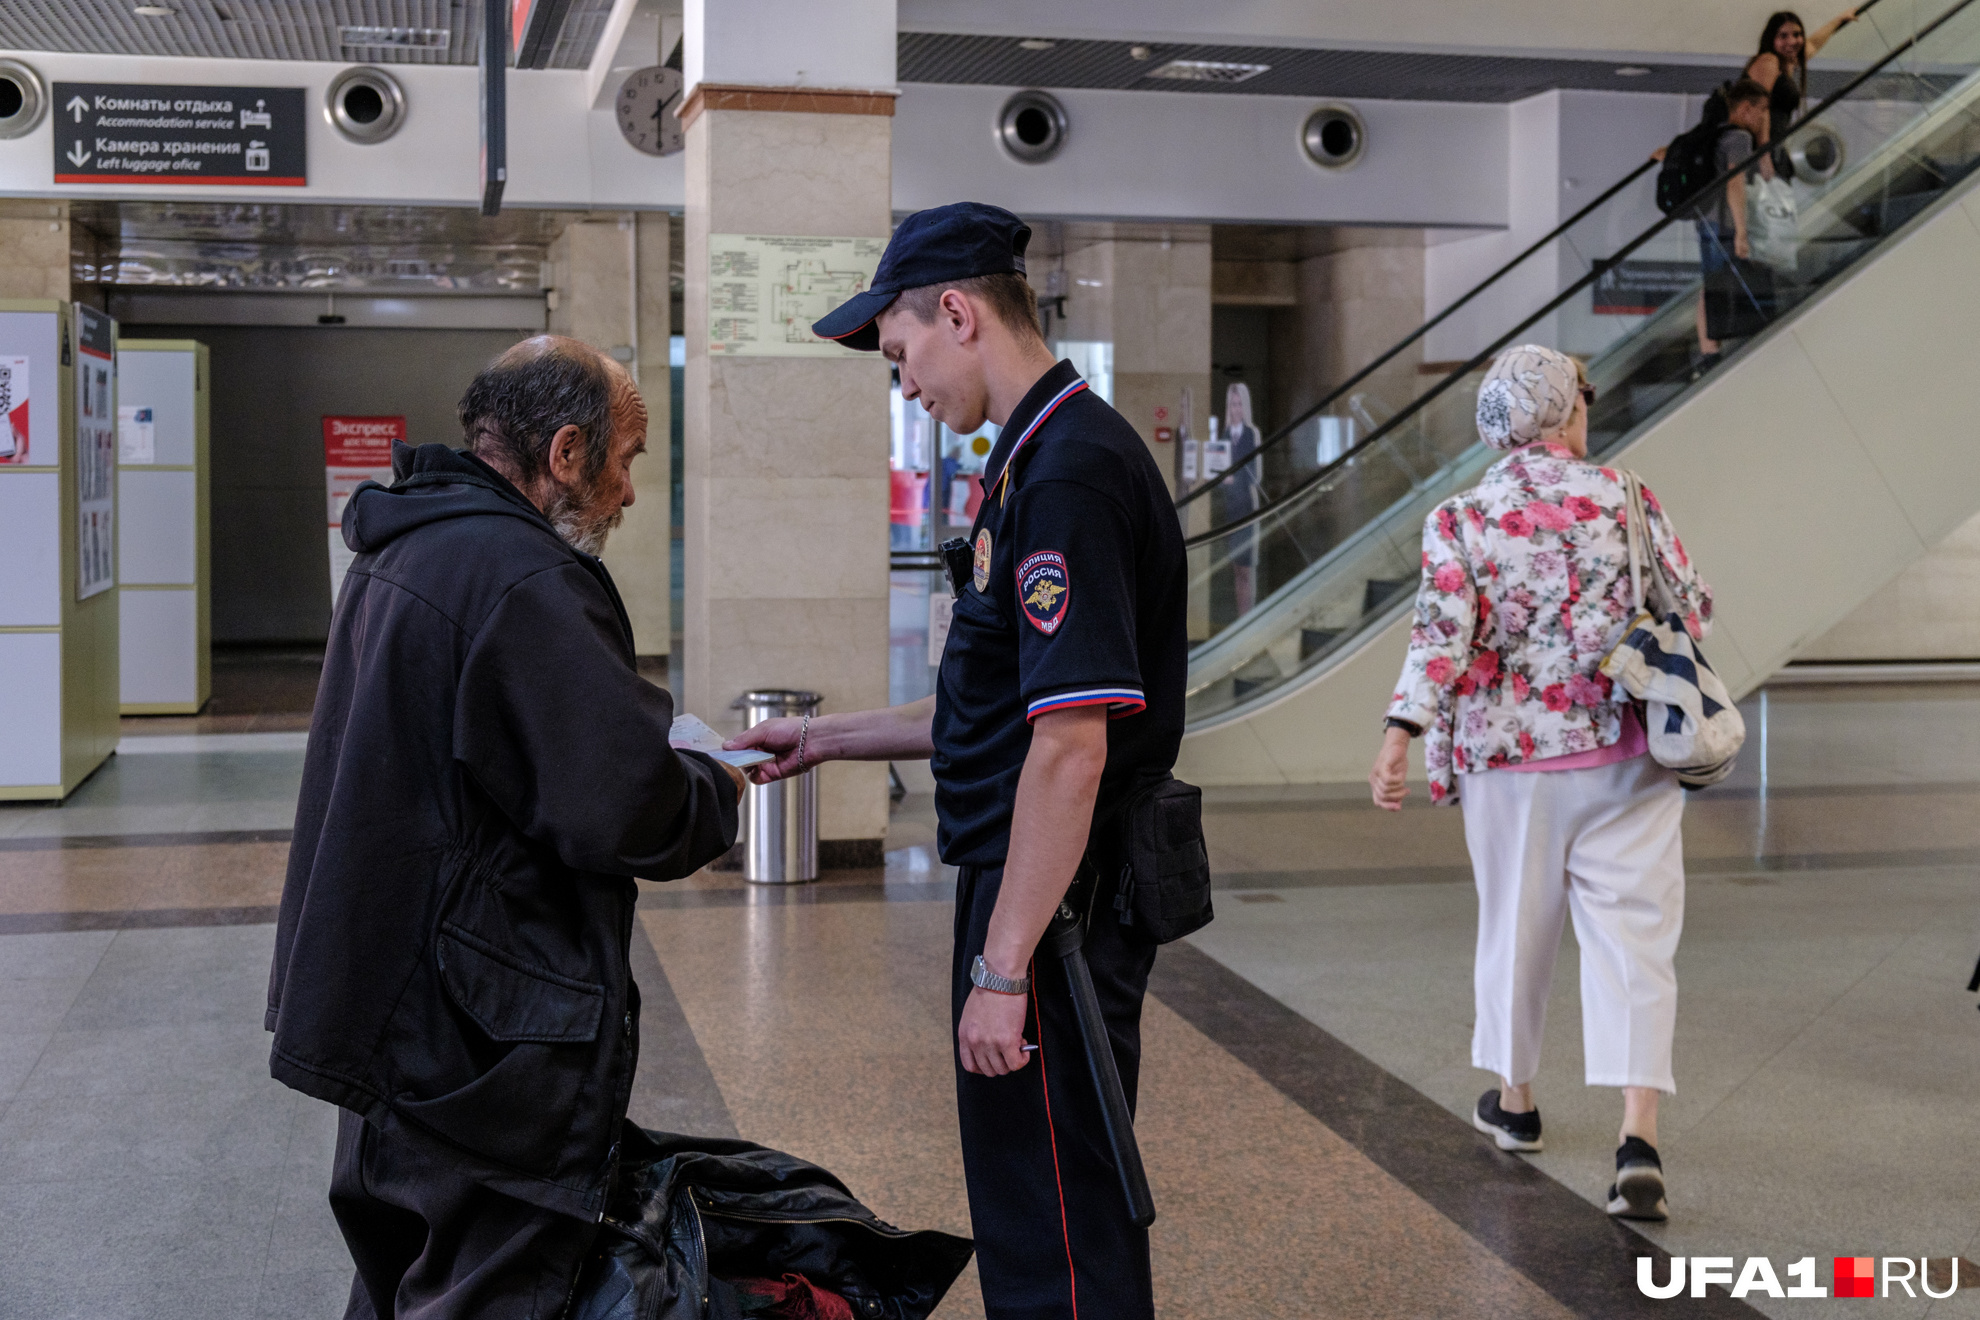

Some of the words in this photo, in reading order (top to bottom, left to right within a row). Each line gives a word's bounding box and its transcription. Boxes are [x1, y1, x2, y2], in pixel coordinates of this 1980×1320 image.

[639, 79, 648, 87] 11
[655, 73, 664, 83] 12
[626, 89, 636, 99] 10
[95, 95, 171, 112] Комнаты
[174, 99, 233, 114] отдыха
[623, 105, 631, 115] 9
[96, 115, 194, 129] Accommodation
[195, 116, 235, 130] service
[673, 134, 680, 144] 5
[95, 138, 160, 157] Камера
[162, 140, 241, 157] хранения
[96, 157, 122, 170] Left
[122, 158, 170, 173] luggage
[332, 420, 397, 437] Экспресс
[1018, 553, 1062, 579] ПОЛИЦИЯ
[1023, 567, 1062, 592] РОССИЯ
[1041, 616, 1059, 633] МВД
